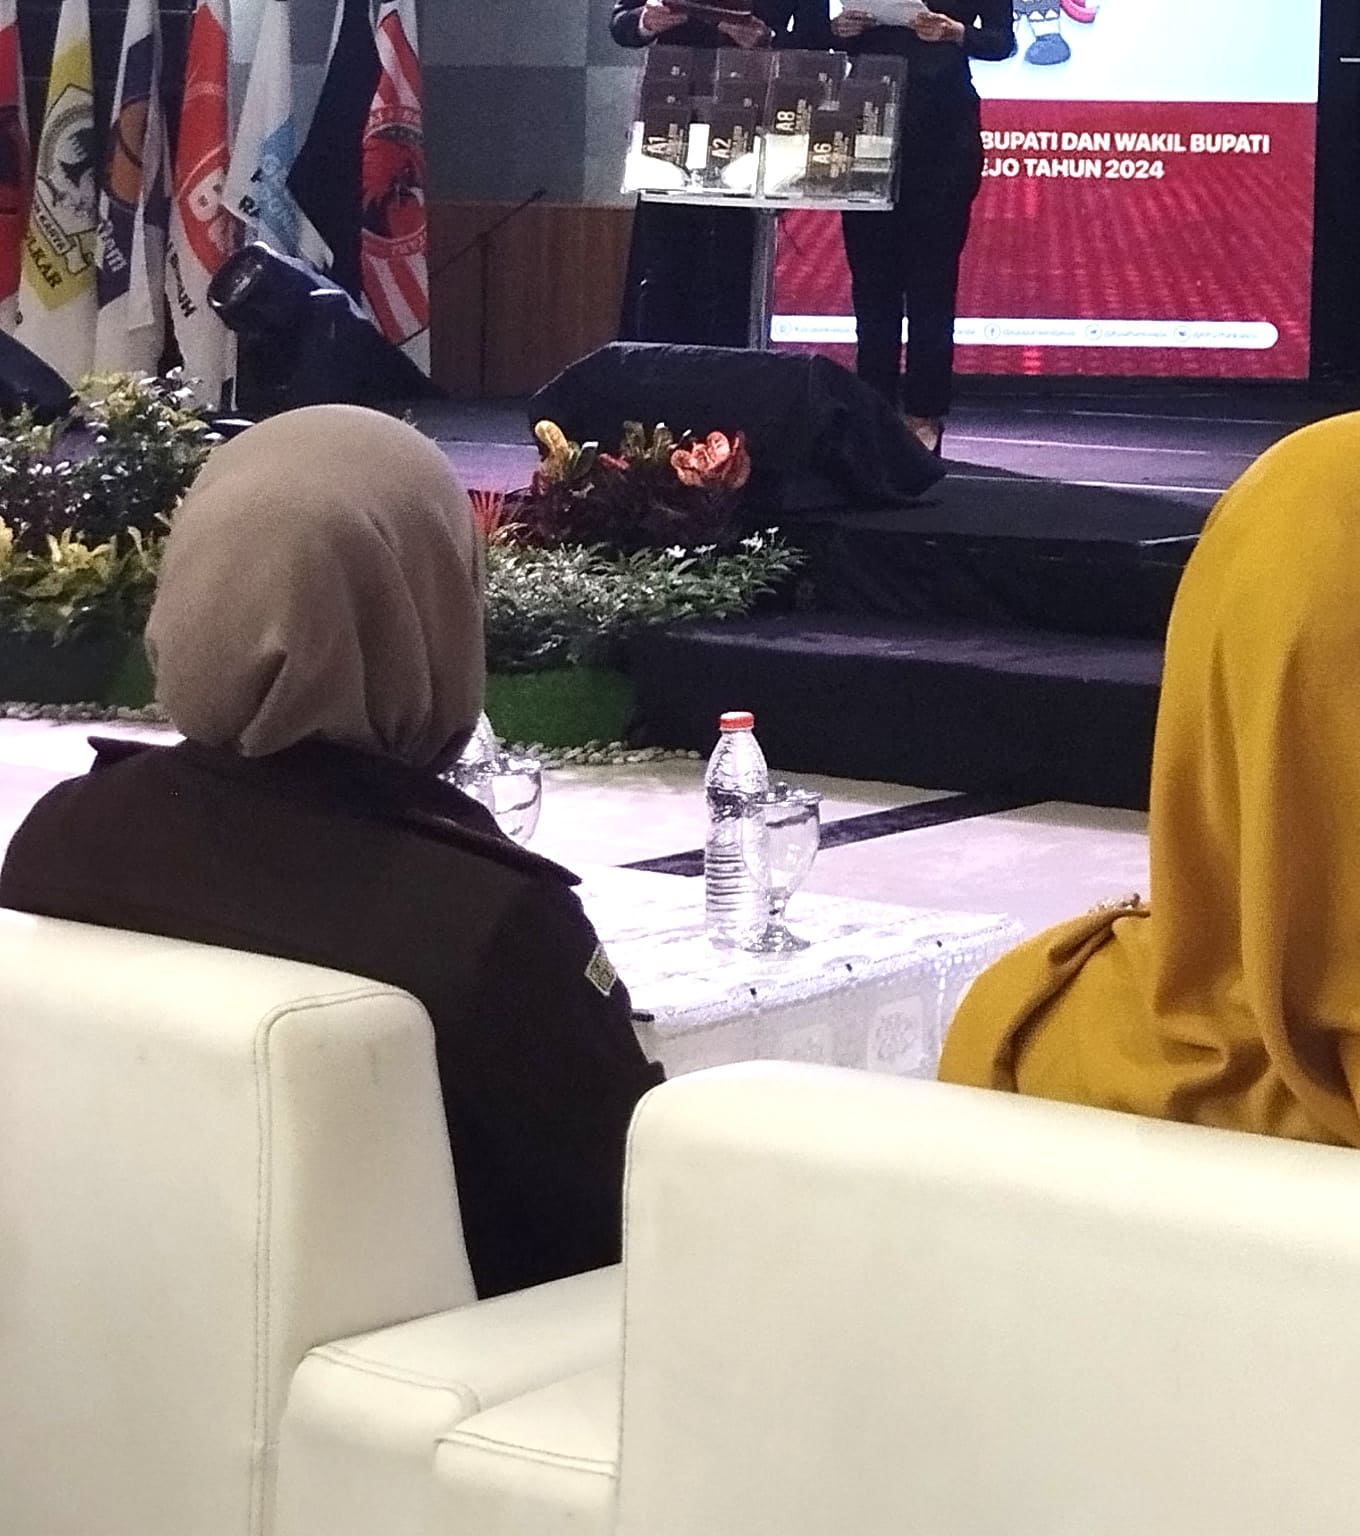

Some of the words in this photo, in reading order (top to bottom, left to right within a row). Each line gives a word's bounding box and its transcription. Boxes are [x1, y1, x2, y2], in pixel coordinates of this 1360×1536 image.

[775, 110, 796, 132] A8
[647, 136, 668, 154] A1
[711, 138, 732, 159] A2
[813, 142, 832, 164] A6
[1061, 132, 1110, 151] DAN
[1114, 133, 1186, 153] WAKIL
[1190, 134, 1269, 154] BUPATI
[1023, 158, 1102, 178] TAHUN
[1105, 159, 1165, 179] 2024
